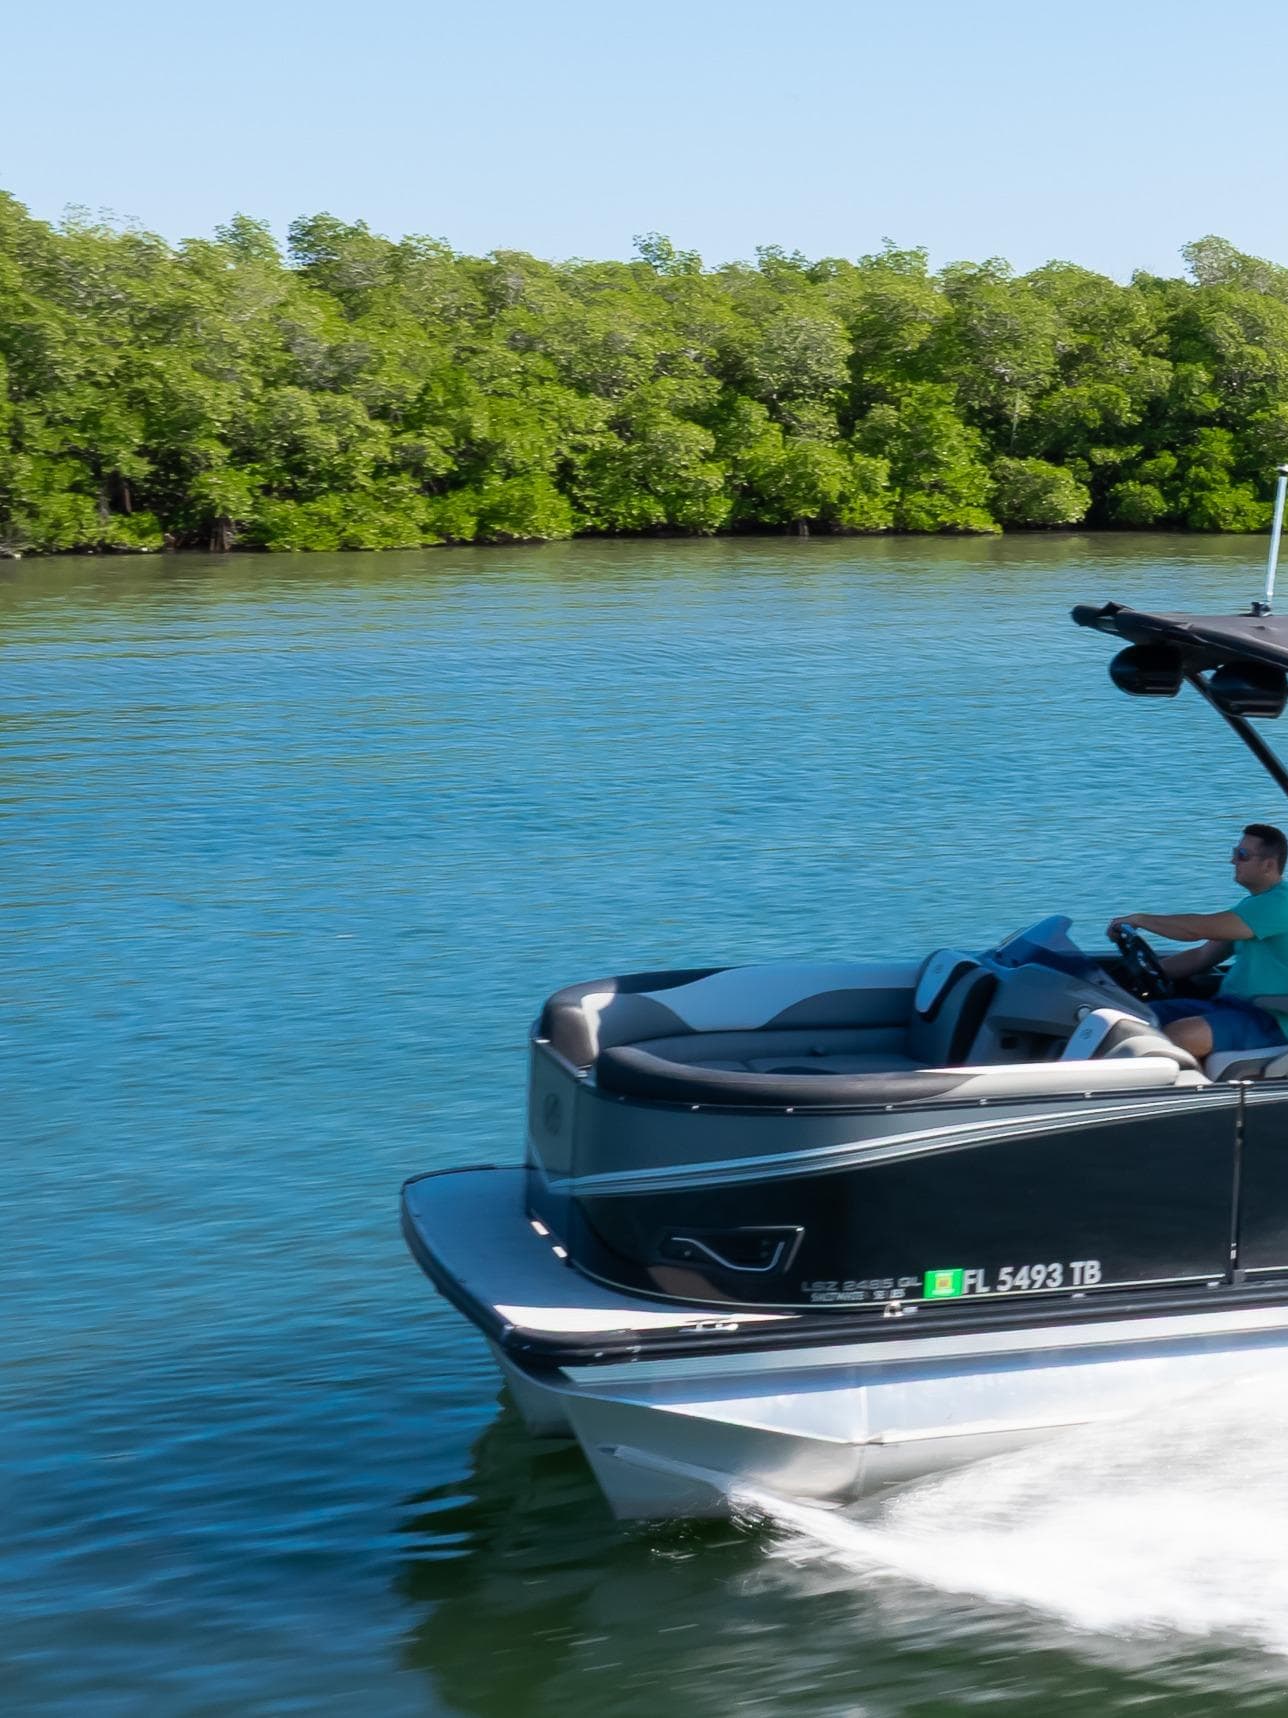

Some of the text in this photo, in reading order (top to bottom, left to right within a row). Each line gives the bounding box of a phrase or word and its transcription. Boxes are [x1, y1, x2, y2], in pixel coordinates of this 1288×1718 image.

[963, 1260, 1102, 1294] FL 5493 TB
